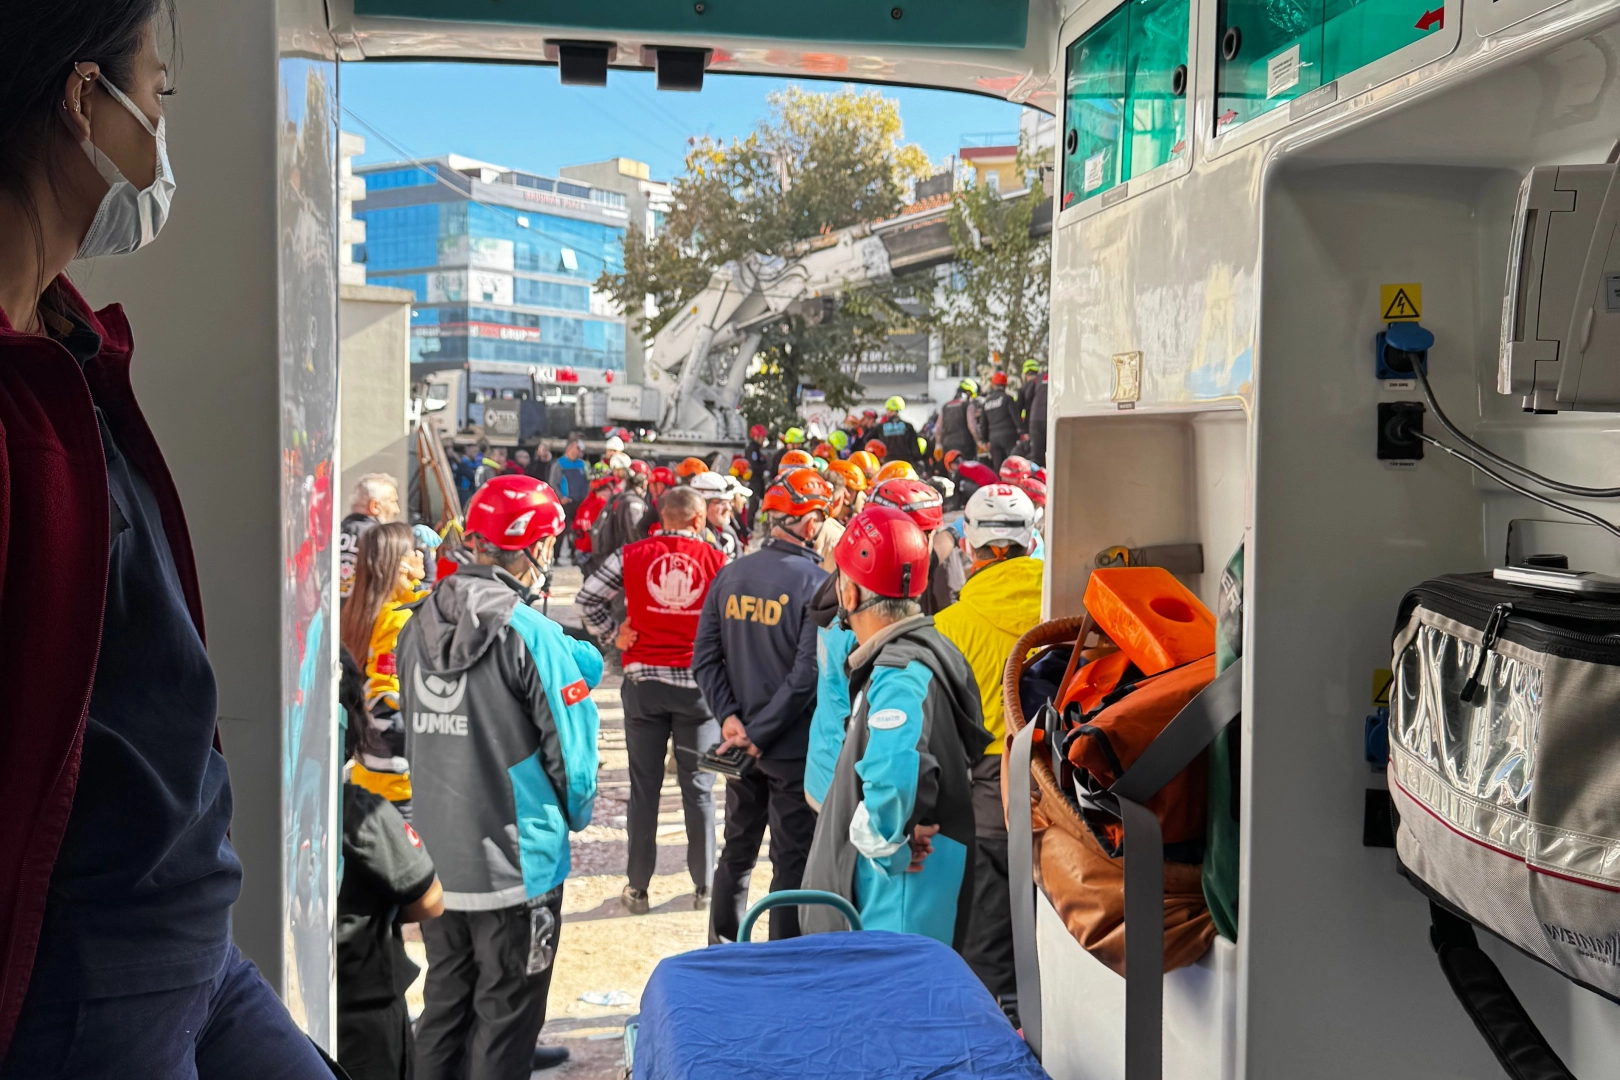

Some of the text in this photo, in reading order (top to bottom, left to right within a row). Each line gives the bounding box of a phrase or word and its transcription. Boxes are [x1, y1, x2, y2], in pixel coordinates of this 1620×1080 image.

[857, 513, 879, 538] CAMP
[725, 594, 782, 626] AFAD
[412, 711, 469, 737] UMKE
